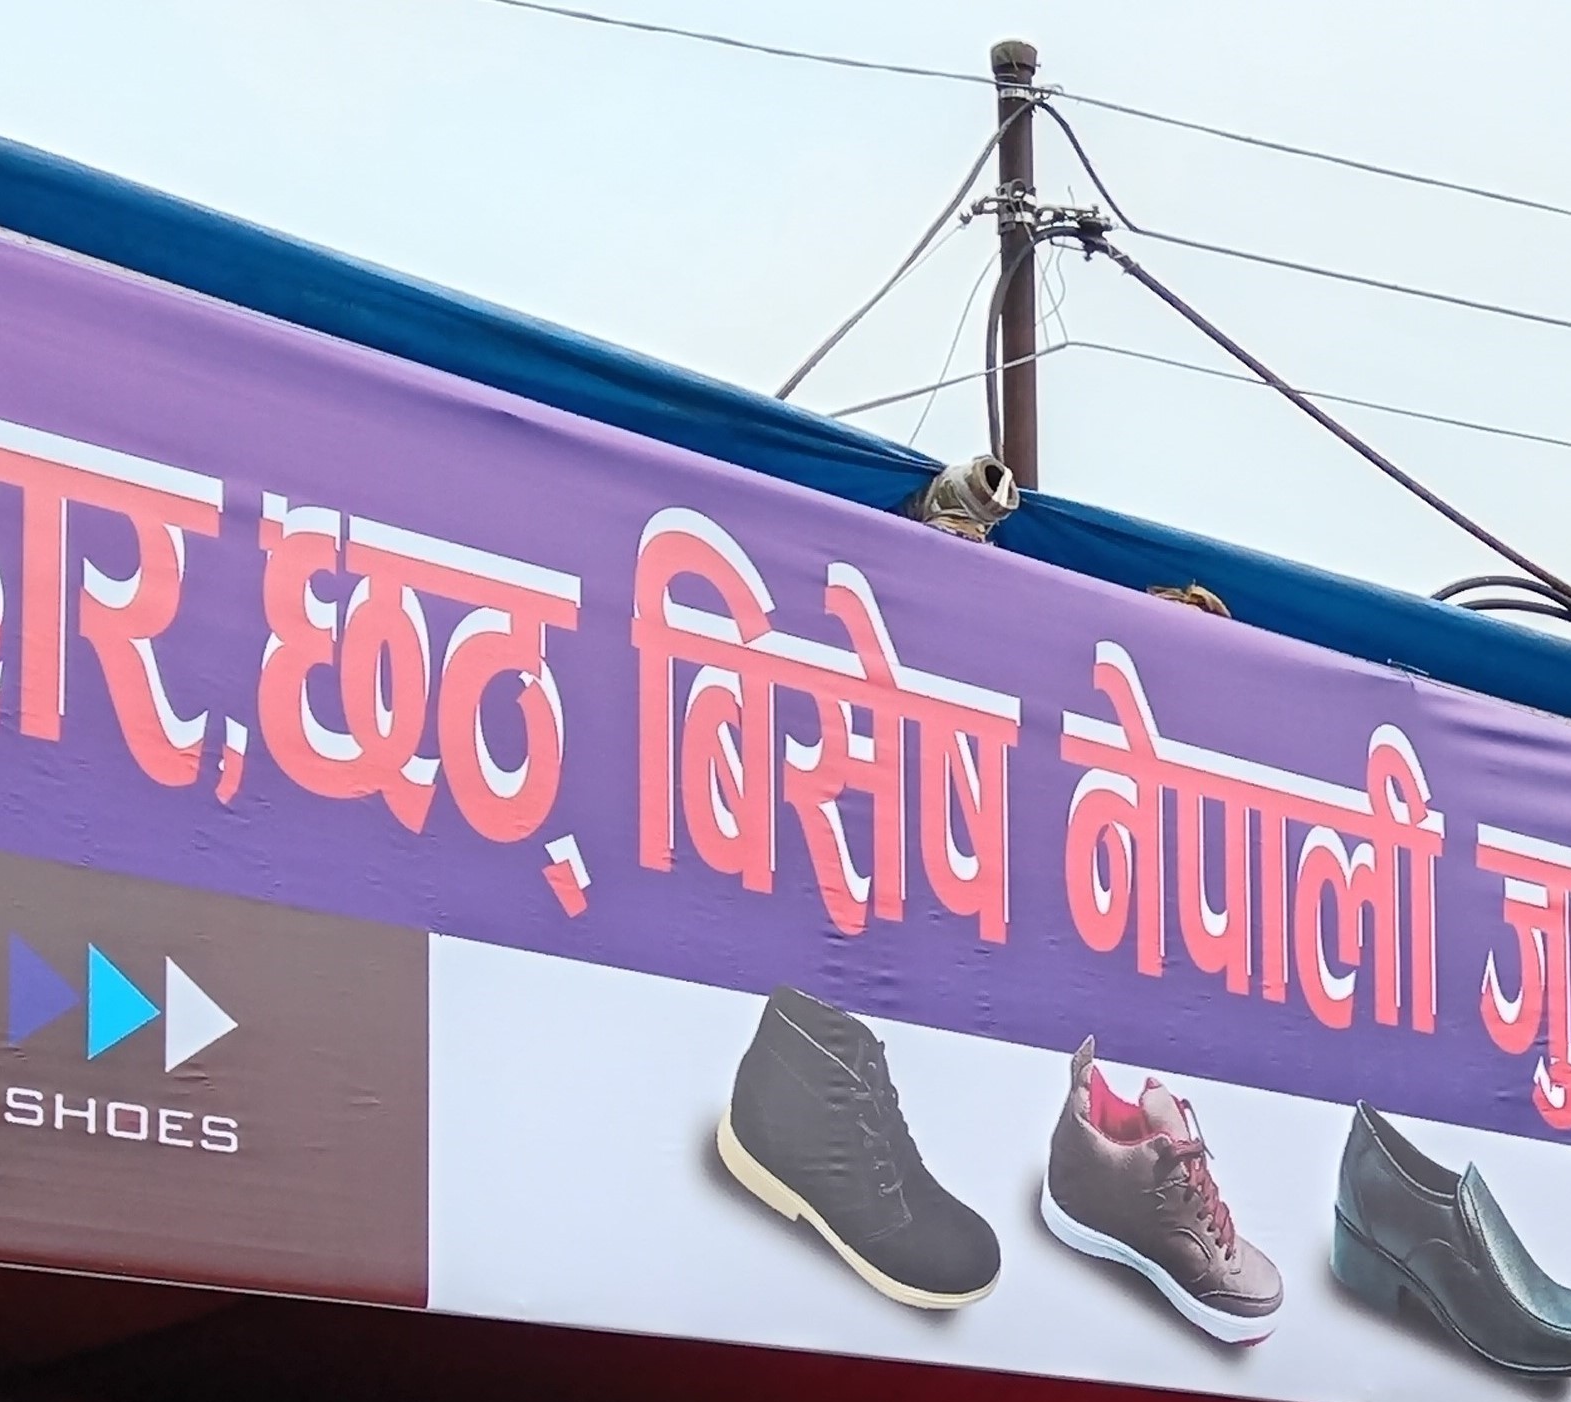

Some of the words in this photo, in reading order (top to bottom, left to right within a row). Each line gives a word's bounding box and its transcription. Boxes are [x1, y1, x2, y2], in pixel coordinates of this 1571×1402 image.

[631, 507, 1021, 944] बिसेष
[1061, 640, 1444, 1034] नेपाली
[3, 1086, 240, 1155] SHOES
